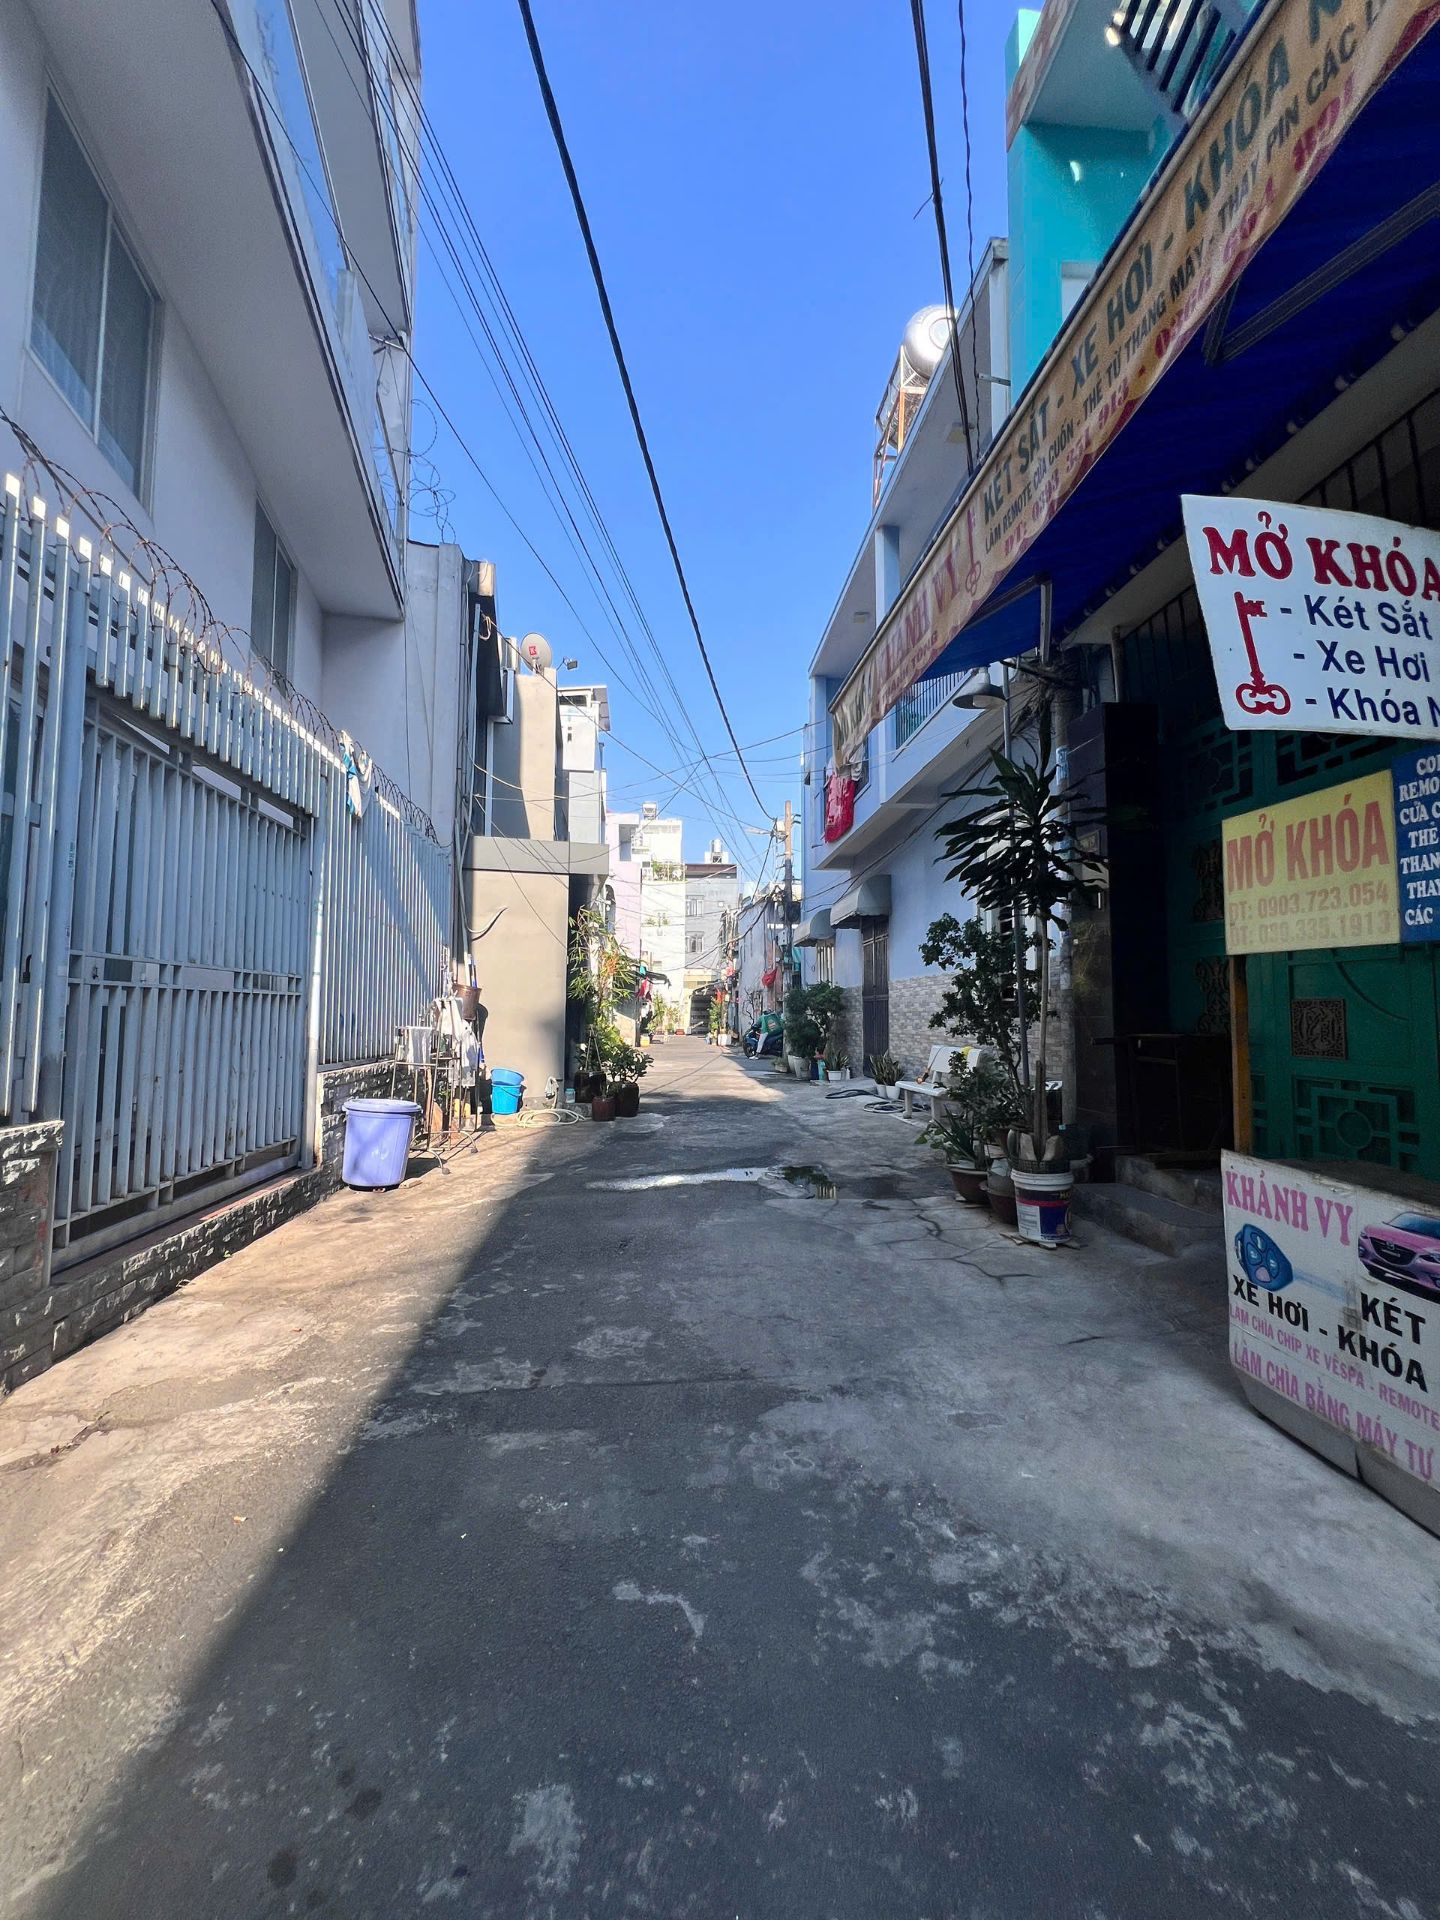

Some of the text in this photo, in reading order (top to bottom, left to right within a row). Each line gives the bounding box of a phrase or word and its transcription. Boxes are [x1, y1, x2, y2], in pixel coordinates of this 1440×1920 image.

[1070, 321, 1099, 399] XE
[1106, 240, 1153, 345] HƠI
[1002, 485, 1033, 535] REMOTE
[1202, 511, 1293, 580] MỞ
[1304, 594, 1370, 631] Két
[1377, 599, 1433, 640] Sắt
[1316, 640, 1366, 675] Xe
[1375, 645, 1431, 682] Hơi
[1327, 686, 1422, 726] Khóa
[1226, 793, 1390, 895] MỞ KHÓA
[1405, 904, 1434, 926] CÁC
[1314, 1196, 1354, 1246] VY
[1232, 1274, 1309, 1332] XE HƠI
[1360, 1291, 1427, 1345] KÉT
[1337, 1324, 1429, 1393] KHÓA
[1233, 1341, 1262, 1379] LÀM
[1266, 1360, 1299, 1401] CHÌA
[1356, 1413, 1398, 1457] MÁY
[1305, 1343, 1320, 1365] XE
[1378, 1381, 1440, 1433] REMOTE
